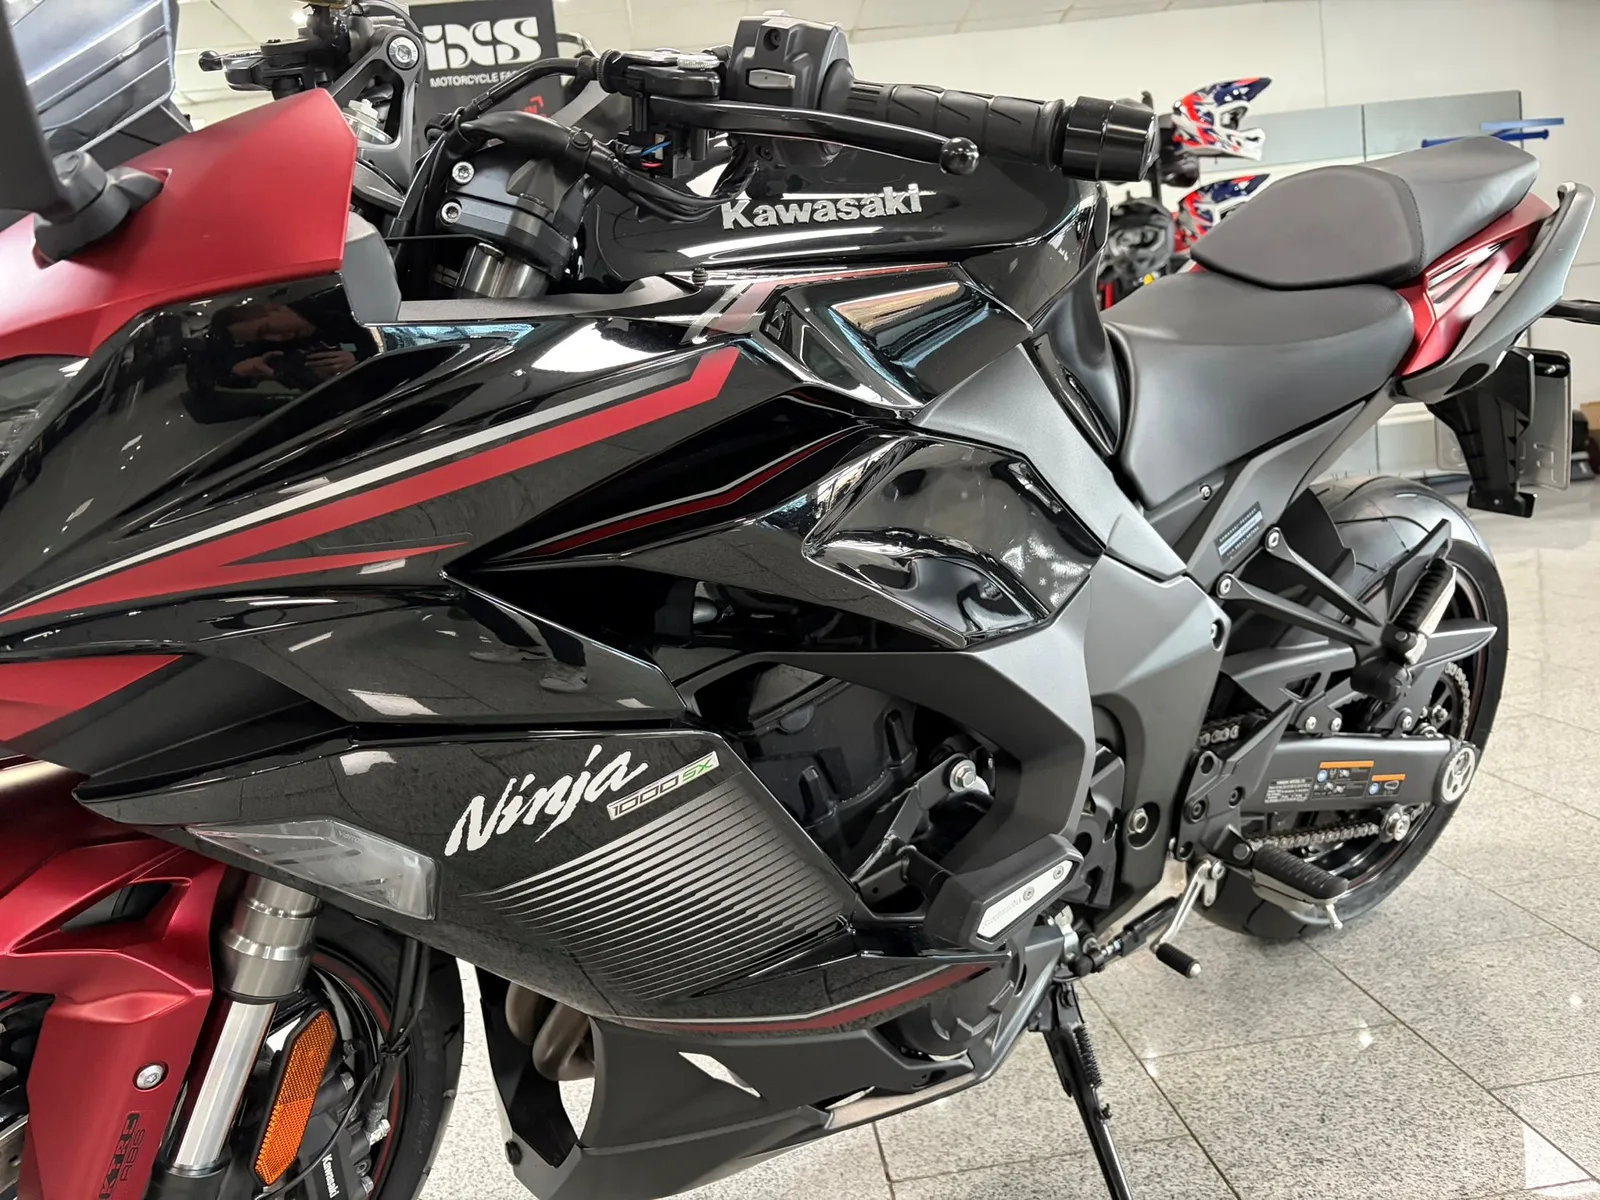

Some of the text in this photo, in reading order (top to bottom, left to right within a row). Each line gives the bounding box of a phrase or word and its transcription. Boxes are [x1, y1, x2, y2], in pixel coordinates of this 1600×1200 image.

[429, 71, 500, 88] MOTORCYCLE
[720, 183, 923, 230] Kawasaki
[444, 744, 716, 857] Ninja 1000SX
[120, 1128, 145, 1181] ABS
[321, 1153, 340, 1199] Kawasaki
